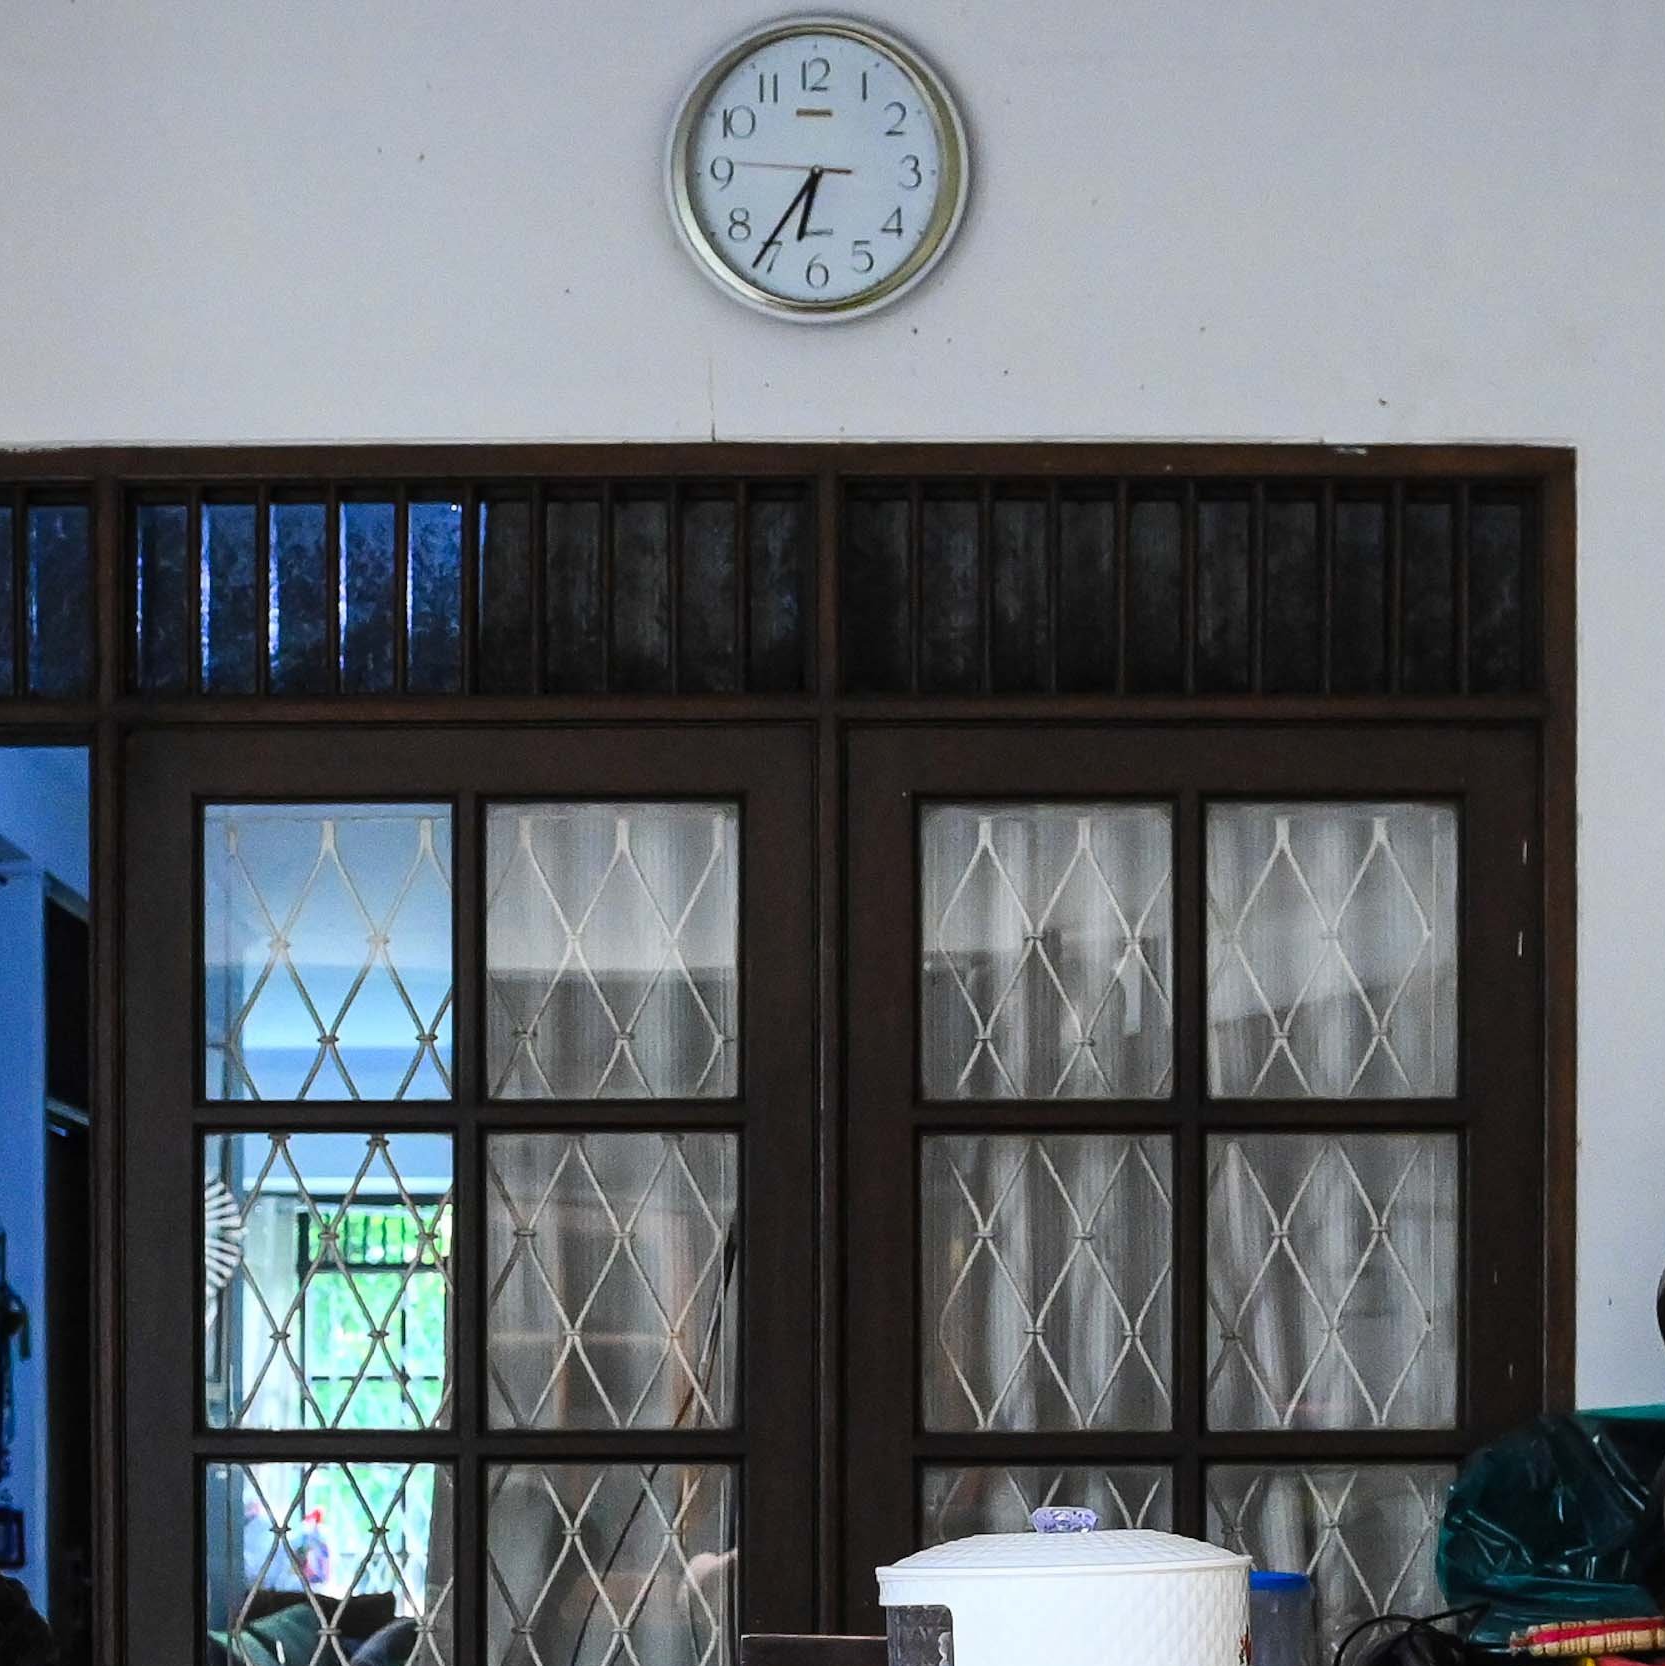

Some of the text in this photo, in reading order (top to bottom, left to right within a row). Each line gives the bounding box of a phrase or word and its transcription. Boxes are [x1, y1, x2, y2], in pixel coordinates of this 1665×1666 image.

[759, 72, 779, 103] 11
[801, 57, 831, 91] 12
[861, 71, 868, 101] 1
[722, 105, 756, 139] 10
[884, 101, 907, 136] 2
[710, 155, 734, 190] 9
[899, 154, 922, 190] 3
[728, 207, 752, 241] 8
[881, 206, 903, 240] 4
[762, 240, 783, 274] 7
[805, 253, 829, 289] 6
[850, 240, 875, 274] 5
